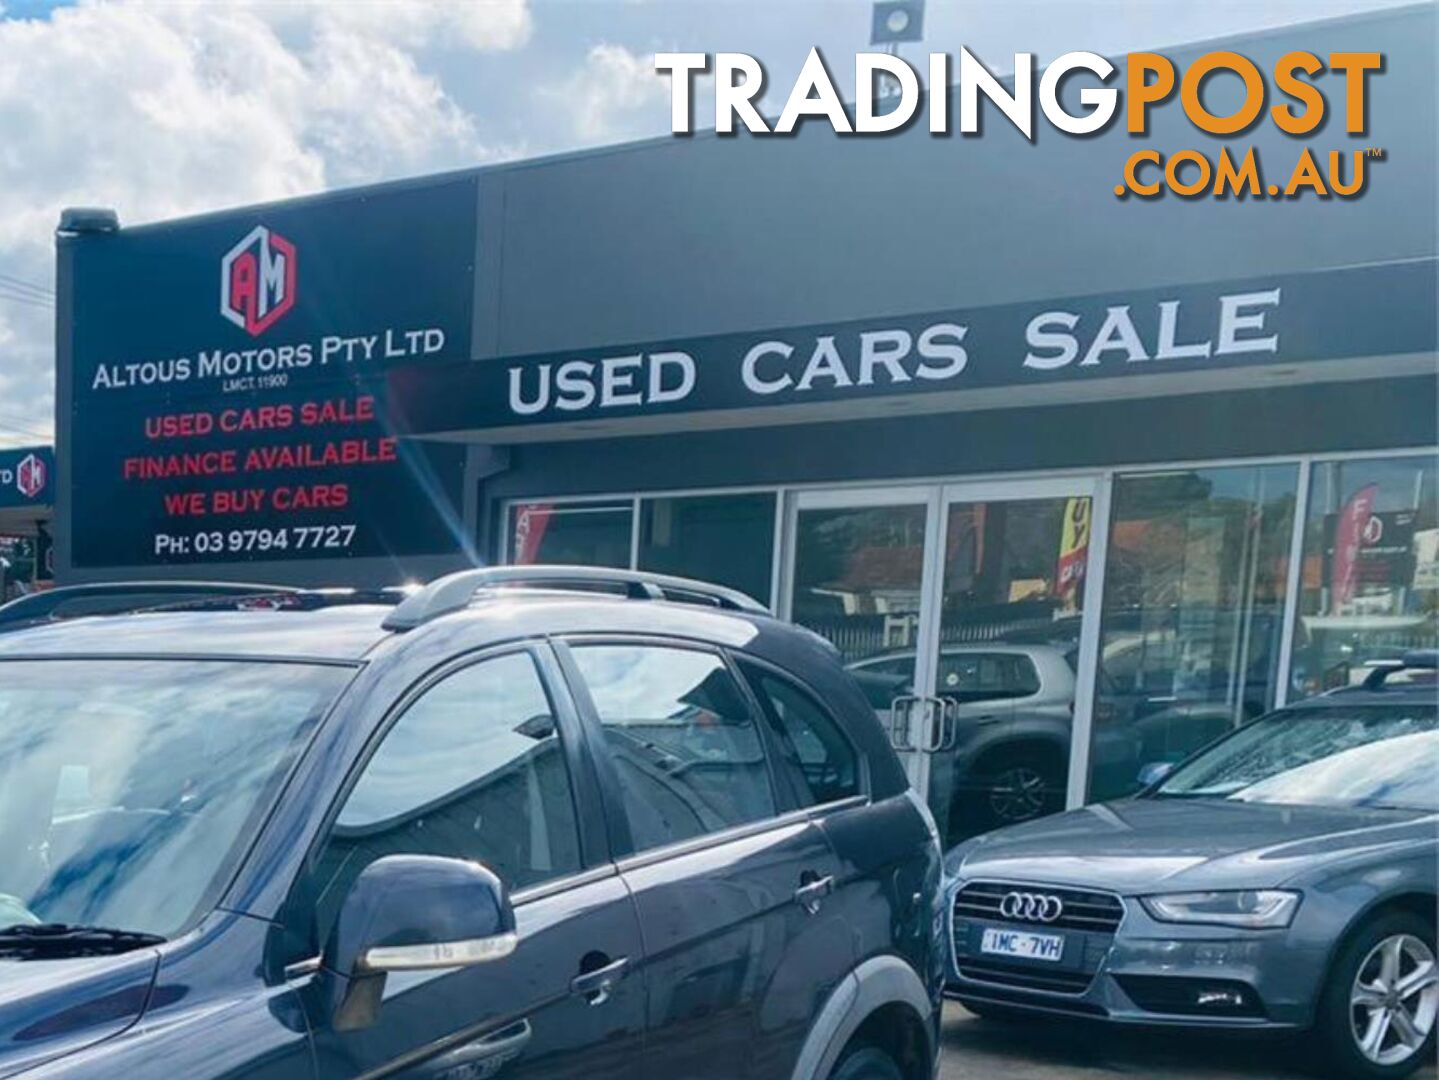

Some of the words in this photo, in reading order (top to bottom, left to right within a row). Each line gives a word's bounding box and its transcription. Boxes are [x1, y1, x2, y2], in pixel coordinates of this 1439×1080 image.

[92, 358, 191, 389] ALTOUS
[198, 344, 312, 378] MOTORS
[321, 335, 378, 363] PTY
[385, 328, 445, 357] LTD
[508, 351, 697, 414] USED
[741, 323, 969, 395] CARS
[1022, 288, 1281, 370] SALE
[145, 412, 213, 438] USED
[220, 404, 293, 432] CARS
[300, 395, 375, 425] SALE
[124, 451, 237, 479] FINANCE
[245, 436, 397, 471] AVAILABLE
[165, 493, 206, 516] WE
[213, 489, 266, 514] BUY
[272, 484, 349, 510] CARS
[194, 532, 223, 552] 03
[228, 529, 288, 551] 9794
[293, 525, 356, 549] 7727
